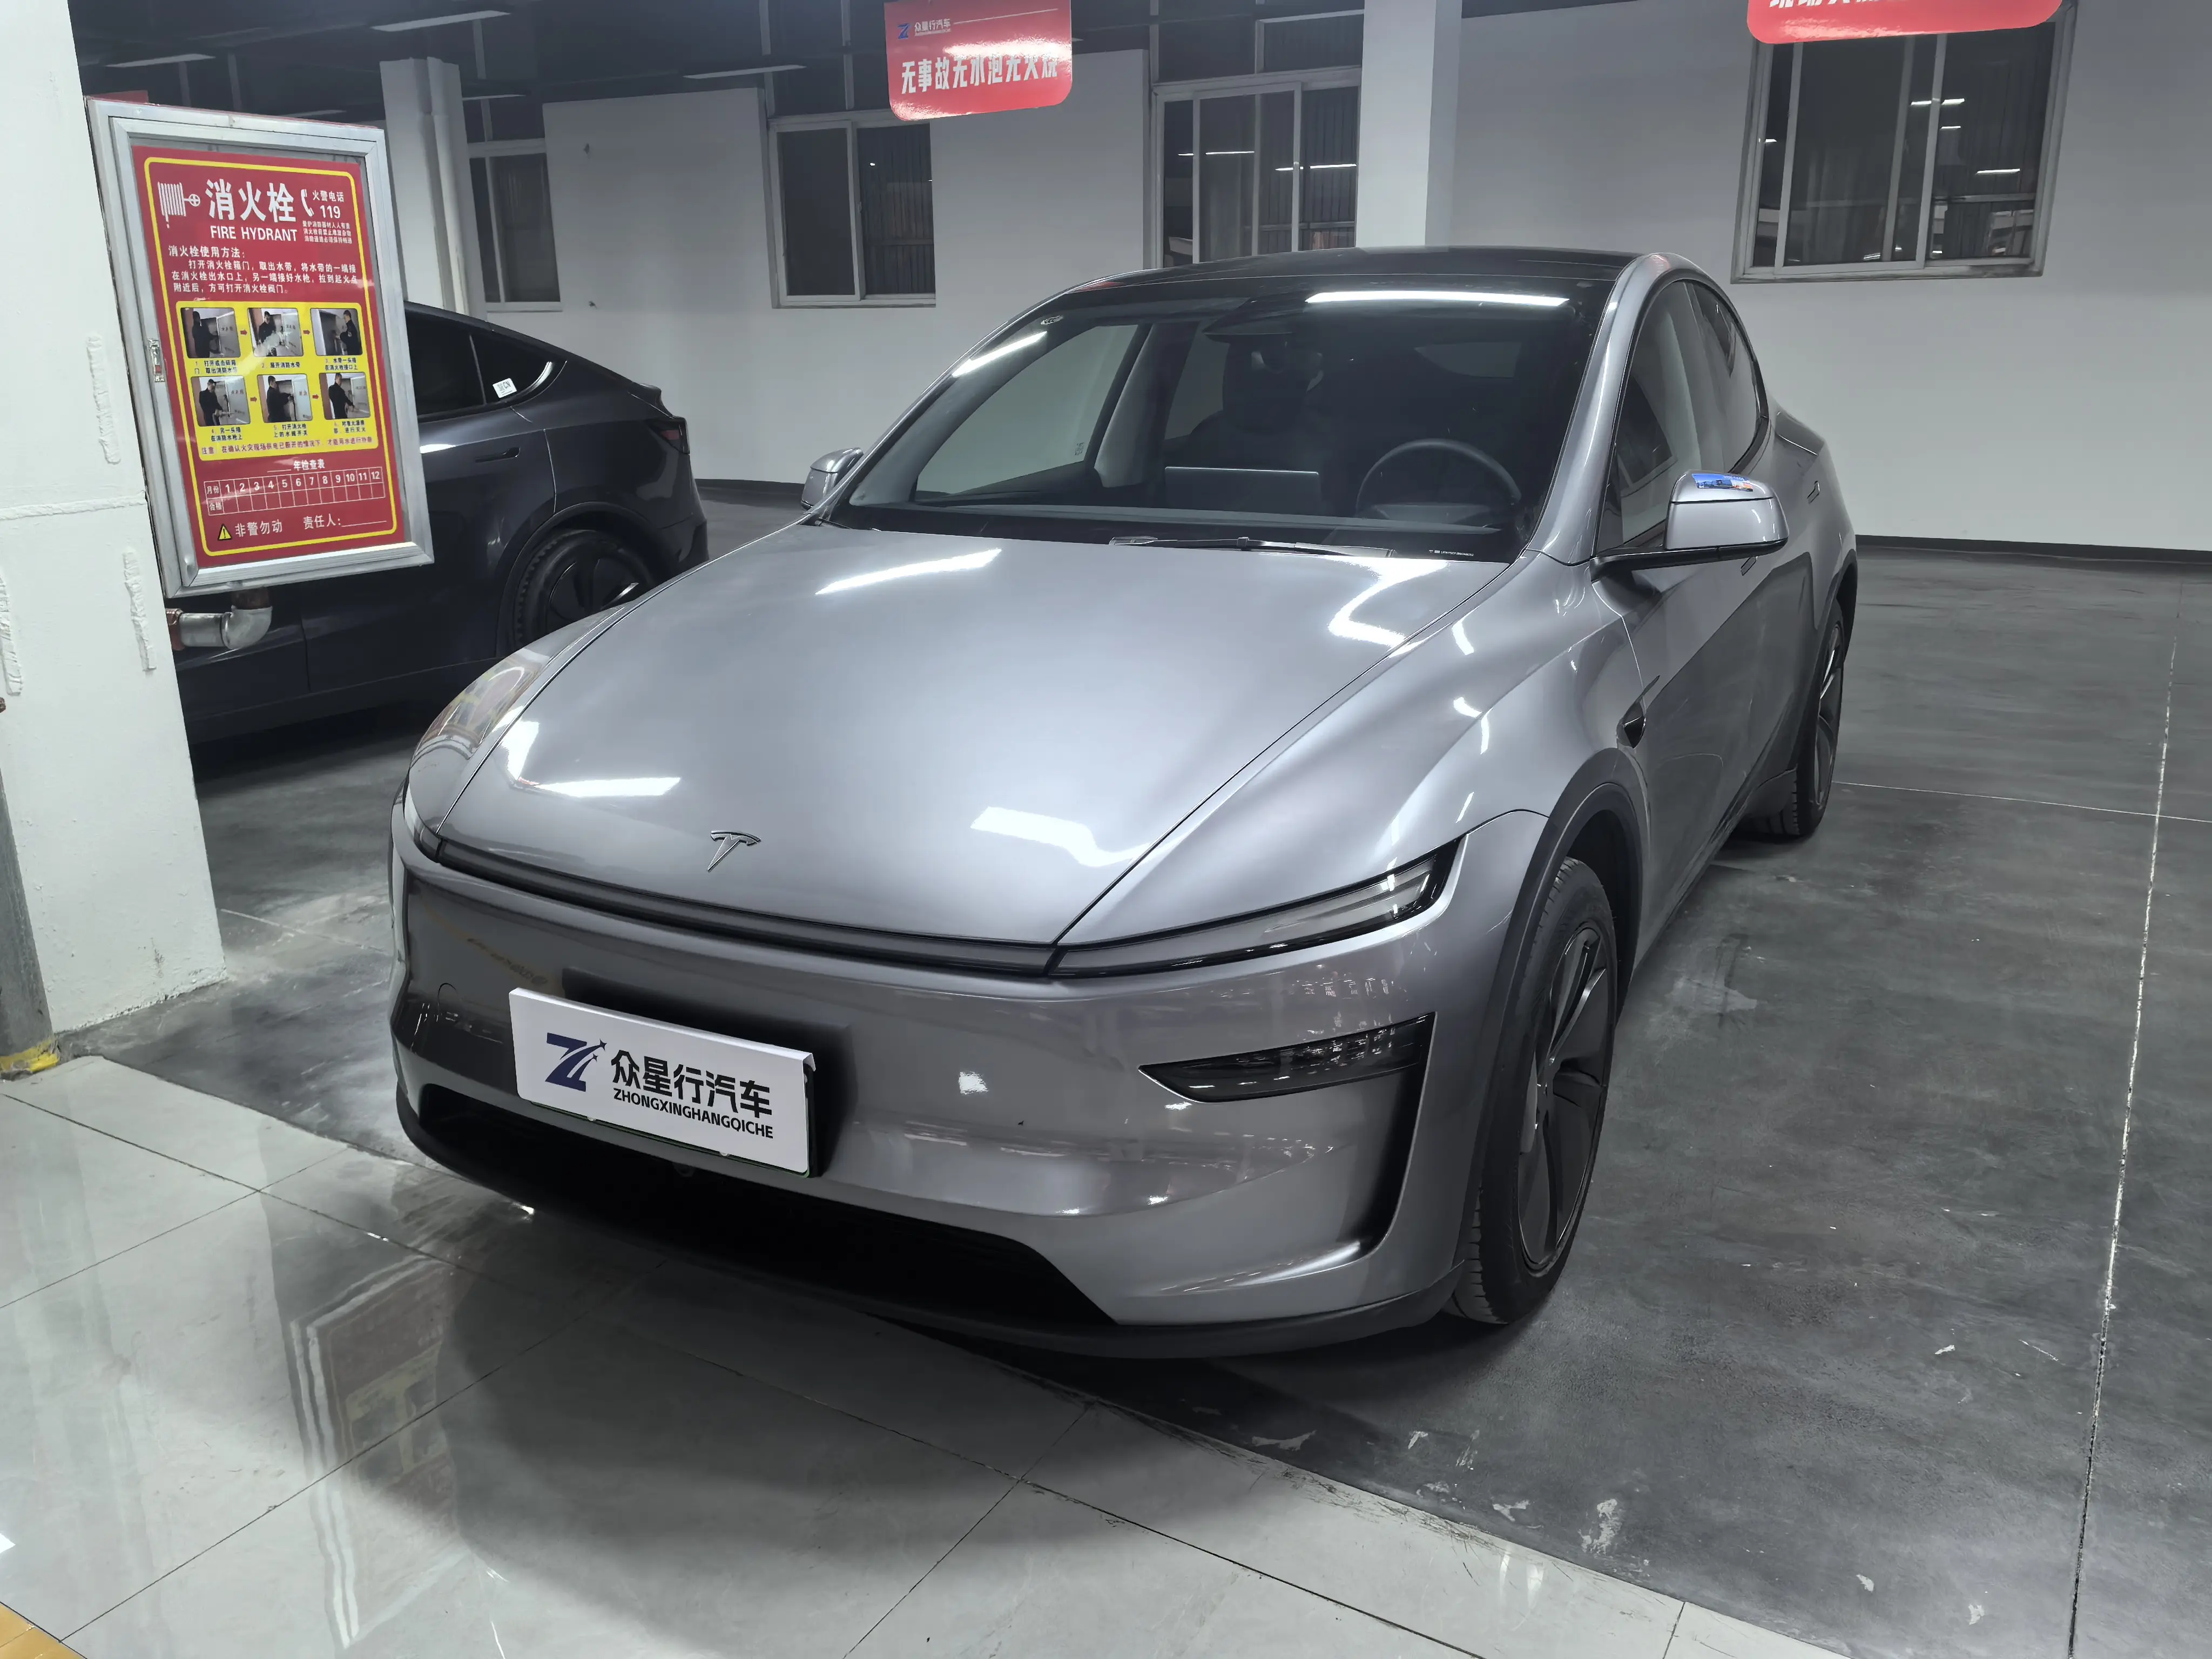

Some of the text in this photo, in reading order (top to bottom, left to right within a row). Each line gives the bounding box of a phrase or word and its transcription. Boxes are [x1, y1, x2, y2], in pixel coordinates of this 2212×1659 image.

[205, 179, 296, 222] 消火栓
[312, 190, 344, 202] 火警电话
[320, 205, 341, 219] 119
[210, 225, 298, 242] FIRE HYDRANT
[207, 471, 380, 495] 月份 1 2 3 4 5 6 7 8 9 10 11 12
[209, 502, 222, 511] 合格
[235, 520, 282, 537] 非警勿动
[611, 1049, 773, 1119] 众星行汽车
[613, 1088, 773, 1139] ZHONGXINGHANGQICHE
